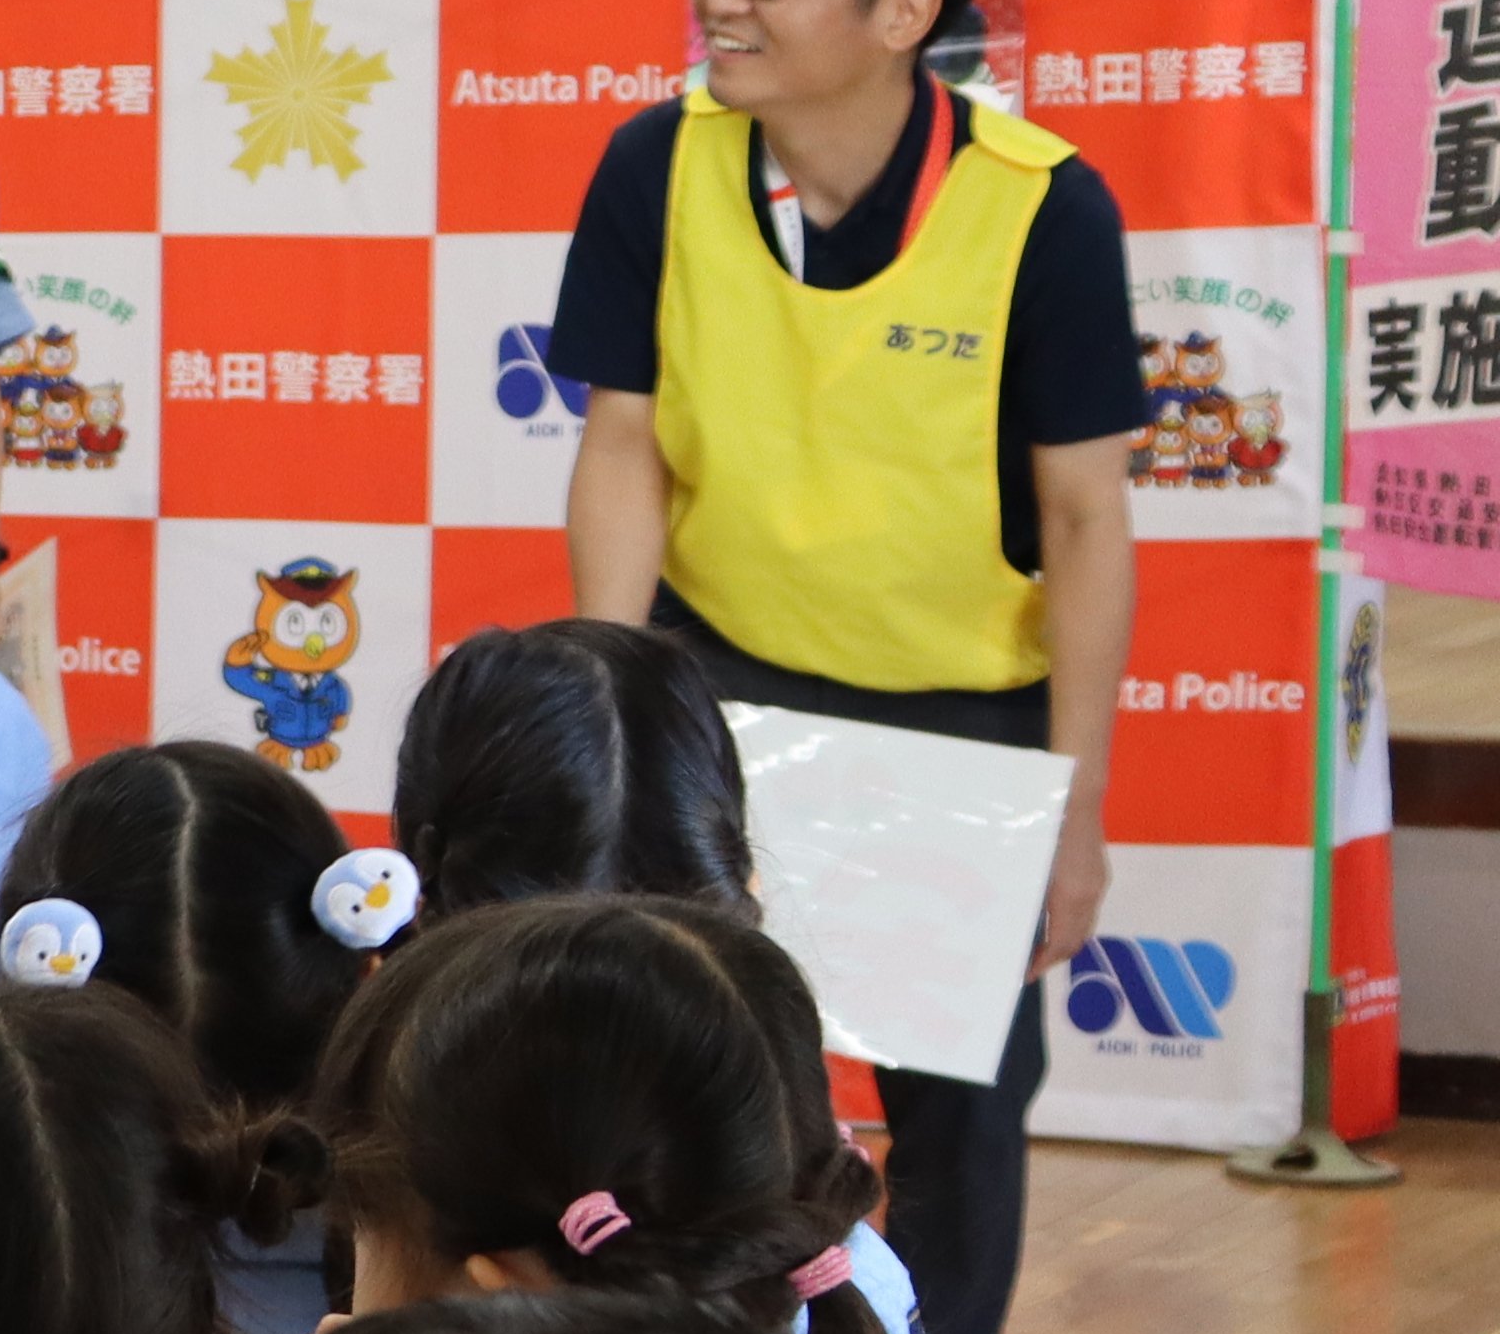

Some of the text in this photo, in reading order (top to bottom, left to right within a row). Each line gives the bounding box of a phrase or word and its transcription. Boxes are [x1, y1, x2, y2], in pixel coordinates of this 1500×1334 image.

[452, 63, 684, 107] Atsuta Polic
[1033, 40, 1309, 106] 熱田警察署
[886, 323, 983, 360] あつた
[1368, 289, 1500, 416] 実施
[167, 350, 425, 406] 熱田警察署
[59, 635, 142, 676] olice
[1173, 670, 1306, 713] Police
